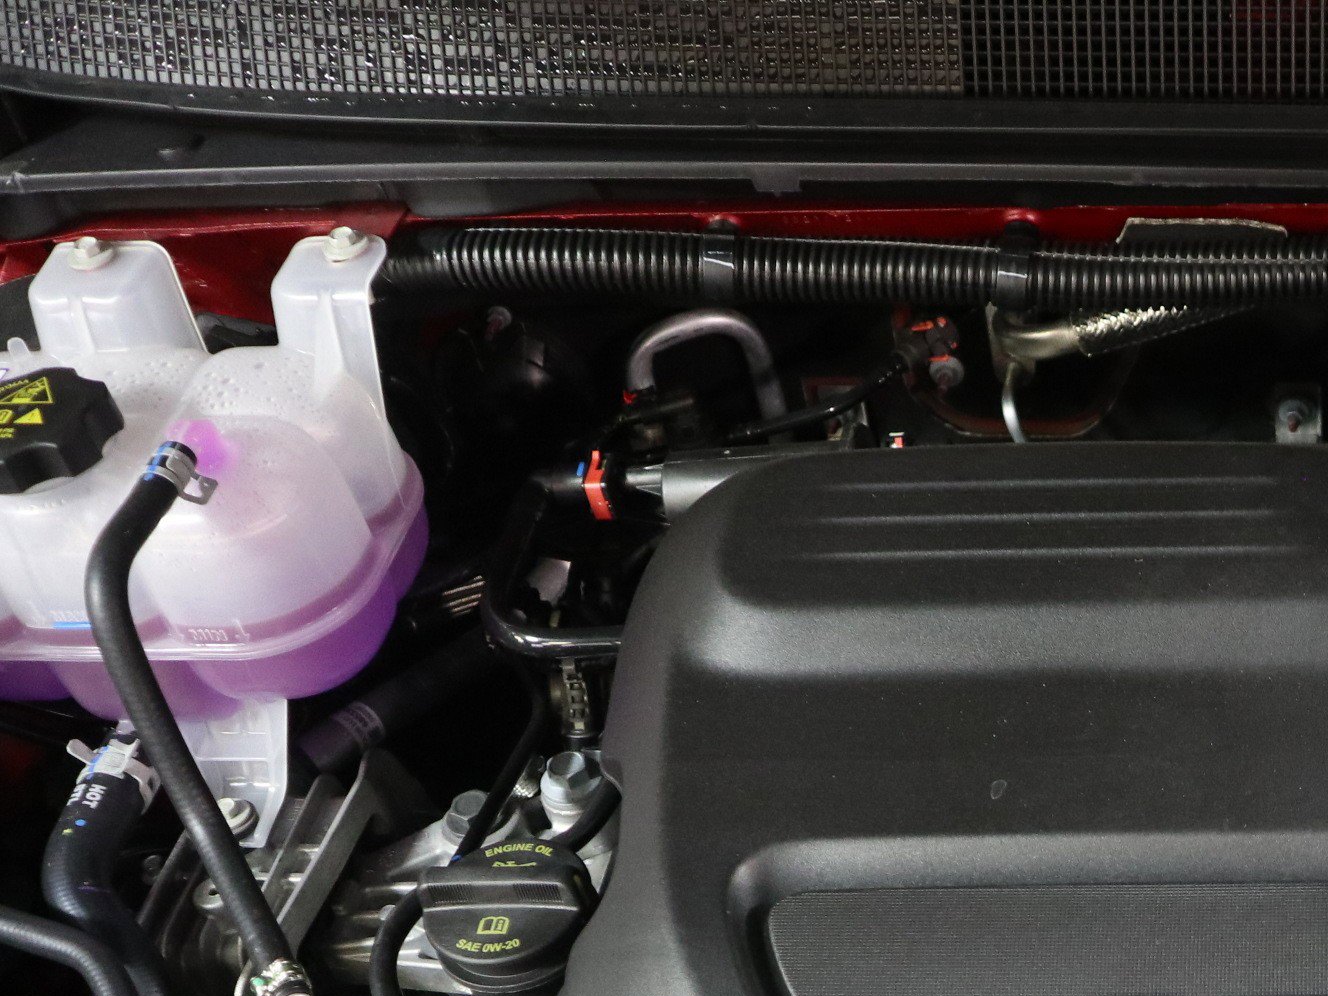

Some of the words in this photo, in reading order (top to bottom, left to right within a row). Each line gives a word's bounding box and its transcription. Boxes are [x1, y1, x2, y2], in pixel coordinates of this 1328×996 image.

[82, 783, 107, 809] HOT
[484, 843, 534, 858] ENGINE
[535, 844, 554, 857] OIL
[456, 938, 481, 952] SAE
